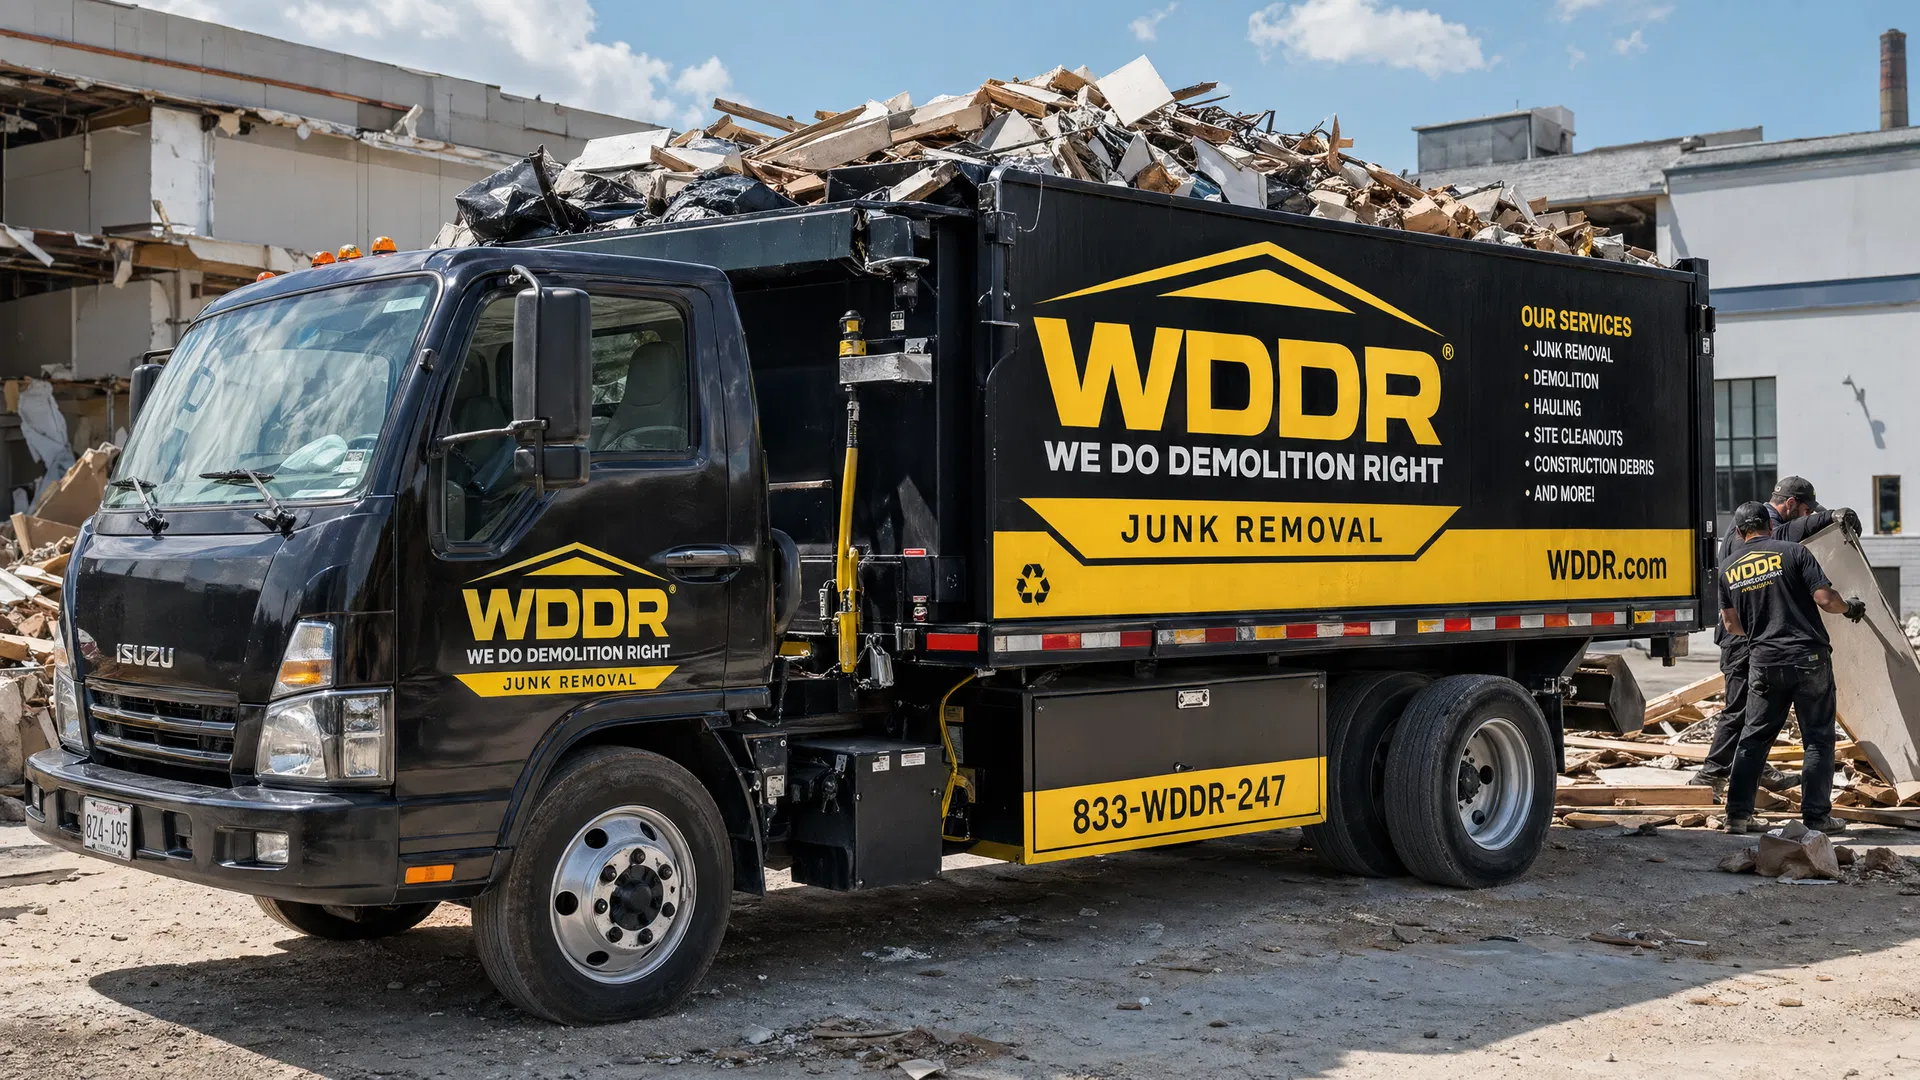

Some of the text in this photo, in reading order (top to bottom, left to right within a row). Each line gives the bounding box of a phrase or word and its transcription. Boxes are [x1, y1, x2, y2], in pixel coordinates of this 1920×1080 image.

[1521, 305, 1632, 338] OUR SERVICES
[1532, 340, 1614, 363] JUNK REMOVAL
[1533, 368, 1599, 390] DEMOLITION
[1533, 398, 1582, 417] HAULING
[1533, 426, 1623, 447] SITE CLEANOUTS
[1043, 440, 1443, 484] WE DO DEMOLITION RIGHT
[1534, 455, 1655, 476] CONSTRUCTION DEBRIS
[1534, 484, 1595, 502] AND MORE!
[1121, 514, 1383, 544] JUNK REMOVAL
[1547, 549, 1667, 580] WDDR.com
[1725, 555, 1782, 584] WDDR
[116, 643, 174, 669] ISUZU
[466, 644, 671, 665] WE DO DEMOLITION RIGHT
[503, 673, 637, 691] JUNK REMOVAL
[1073, 774, 1286, 835] 833-WDDR-247
